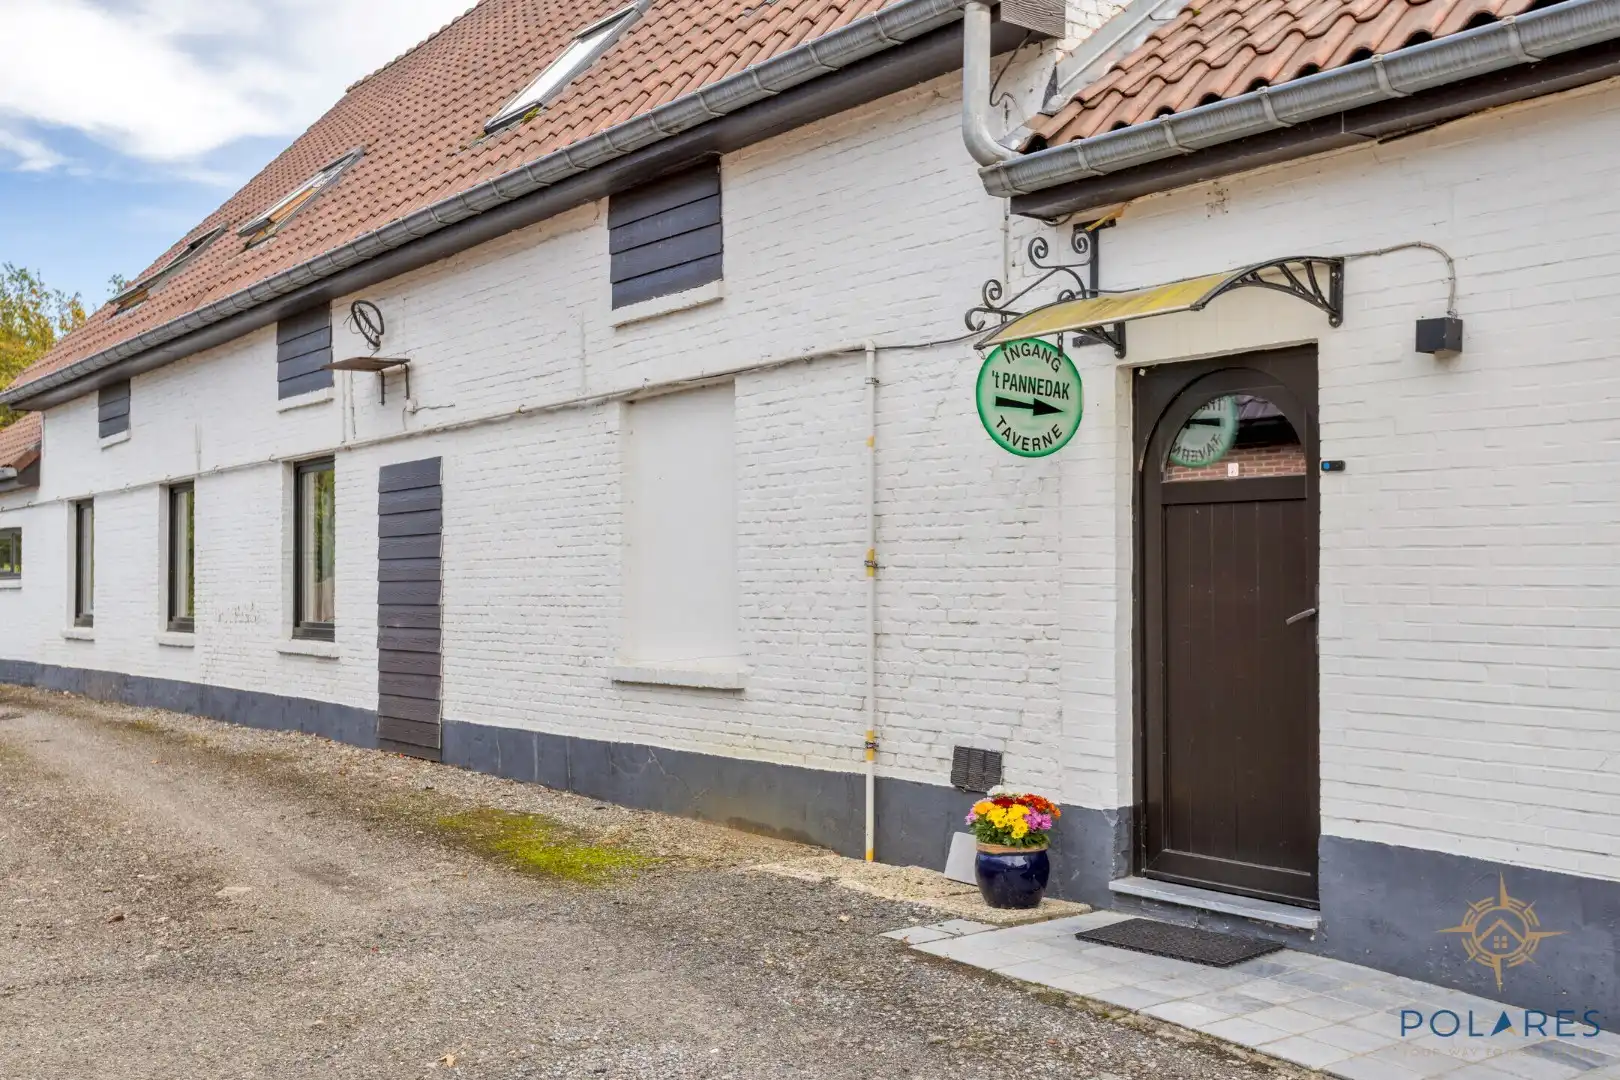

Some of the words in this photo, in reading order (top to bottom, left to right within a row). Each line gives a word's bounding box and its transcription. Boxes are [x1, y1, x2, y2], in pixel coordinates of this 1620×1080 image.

[1003, 342, 1062, 373] INGANG
[1002, 372, 1070, 401] PANNEDAK
[996, 415, 1063, 452] TAVERNE
